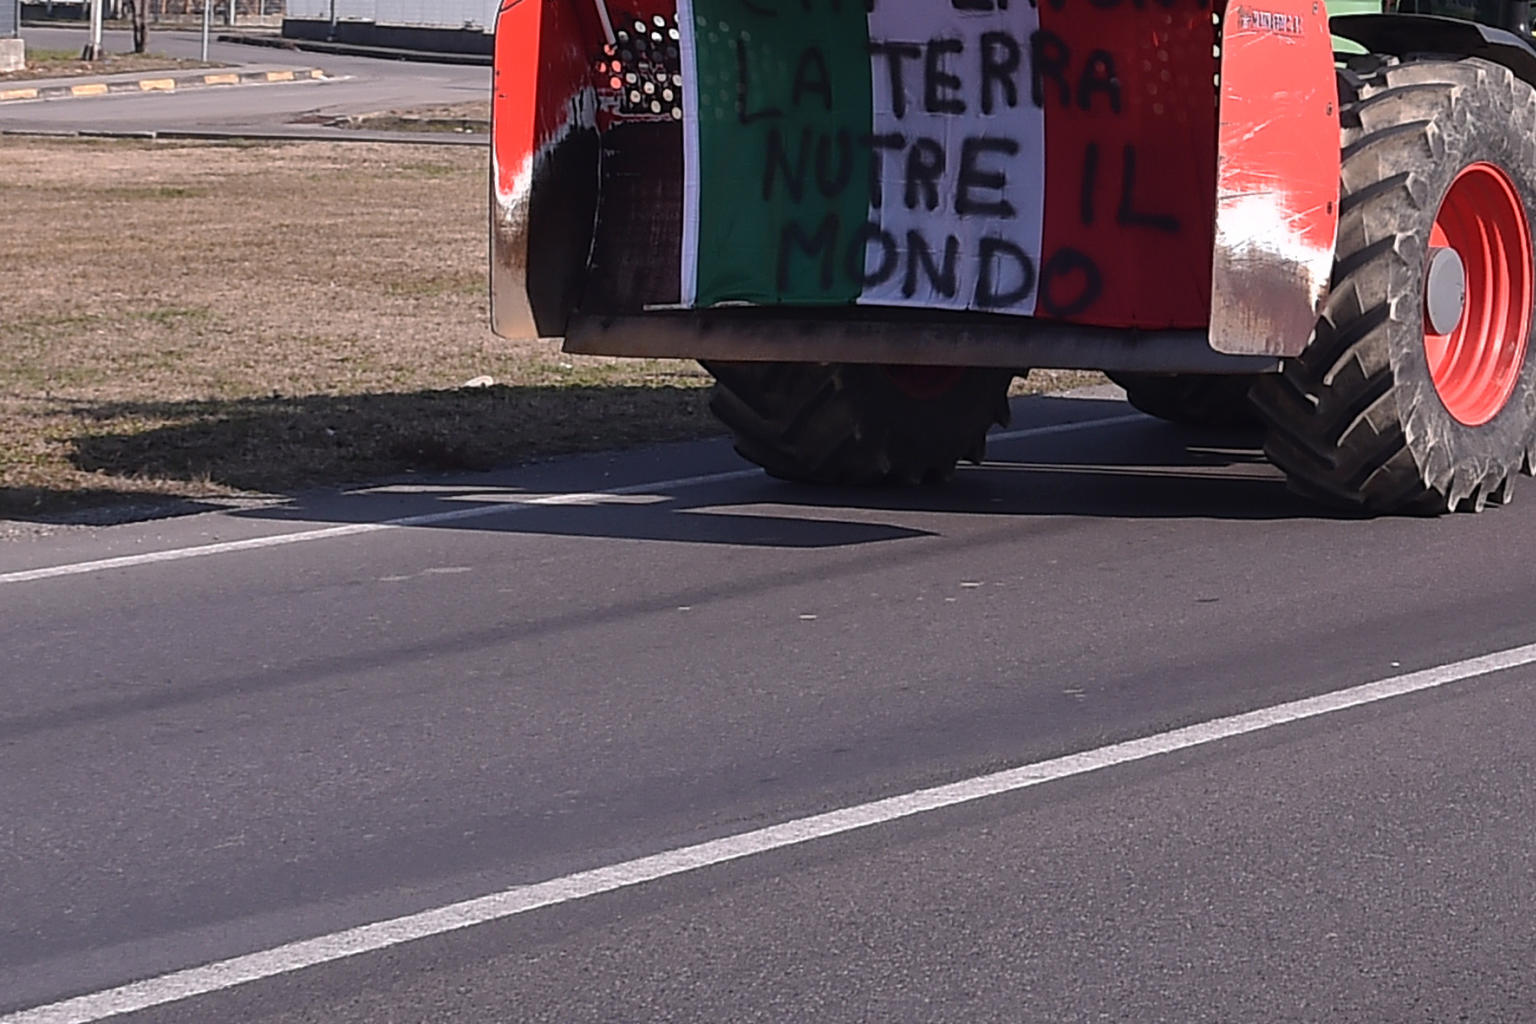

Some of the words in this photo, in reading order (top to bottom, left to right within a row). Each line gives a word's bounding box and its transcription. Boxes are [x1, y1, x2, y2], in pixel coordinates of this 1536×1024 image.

[738, 39, 832, 123] LA
[867, 31, 1121, 119] TERRA
[762, 129, 1020, 218] NUTRE
[1081, 142, 1180, 232] IL
[777, 213, 1104, 317] MONDO
